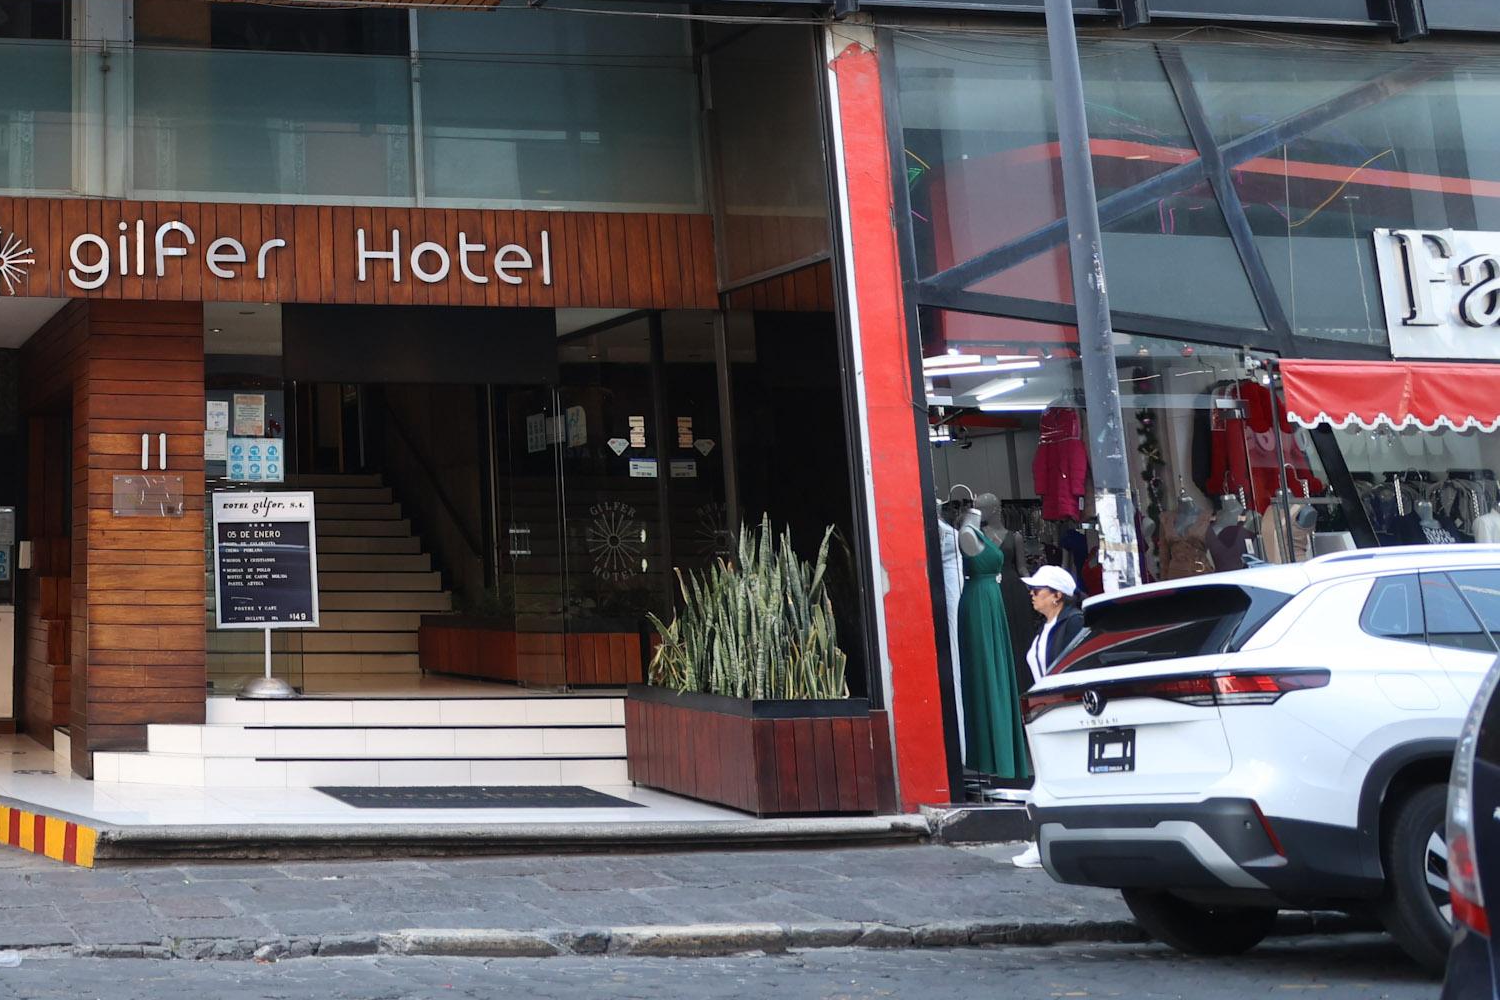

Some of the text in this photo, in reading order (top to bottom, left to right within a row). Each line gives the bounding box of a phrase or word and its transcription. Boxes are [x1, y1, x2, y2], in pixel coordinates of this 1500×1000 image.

[68, 219, 551, 289] gilfer Hotel
[589, 501, 636, 518] GILFER
[254, 530, 281, 538] ENERO
[592, 565, 637, 582] HOTEL
